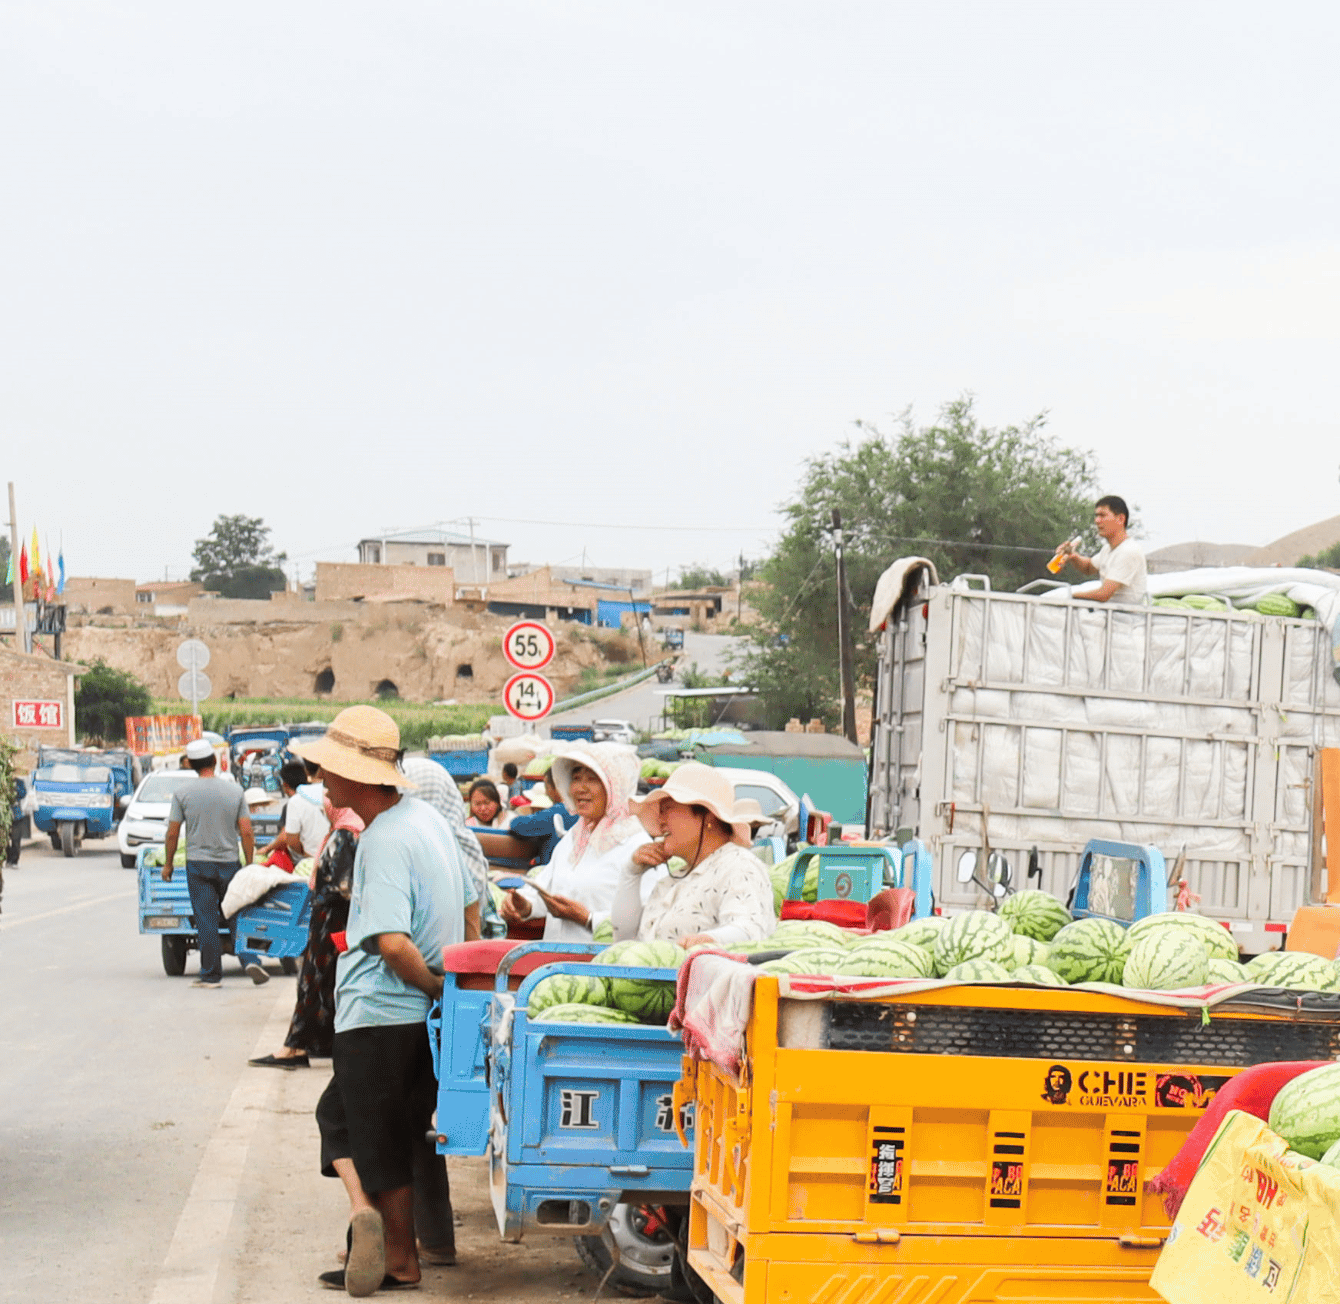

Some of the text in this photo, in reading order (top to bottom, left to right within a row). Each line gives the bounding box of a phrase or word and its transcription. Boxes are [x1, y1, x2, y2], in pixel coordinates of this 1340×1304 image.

[17, 703, 58, 725] 饭馆
[1078, 1070, 1147, 1095] CHE
[1080, 1095, 1147, 1107] GUEVARA
